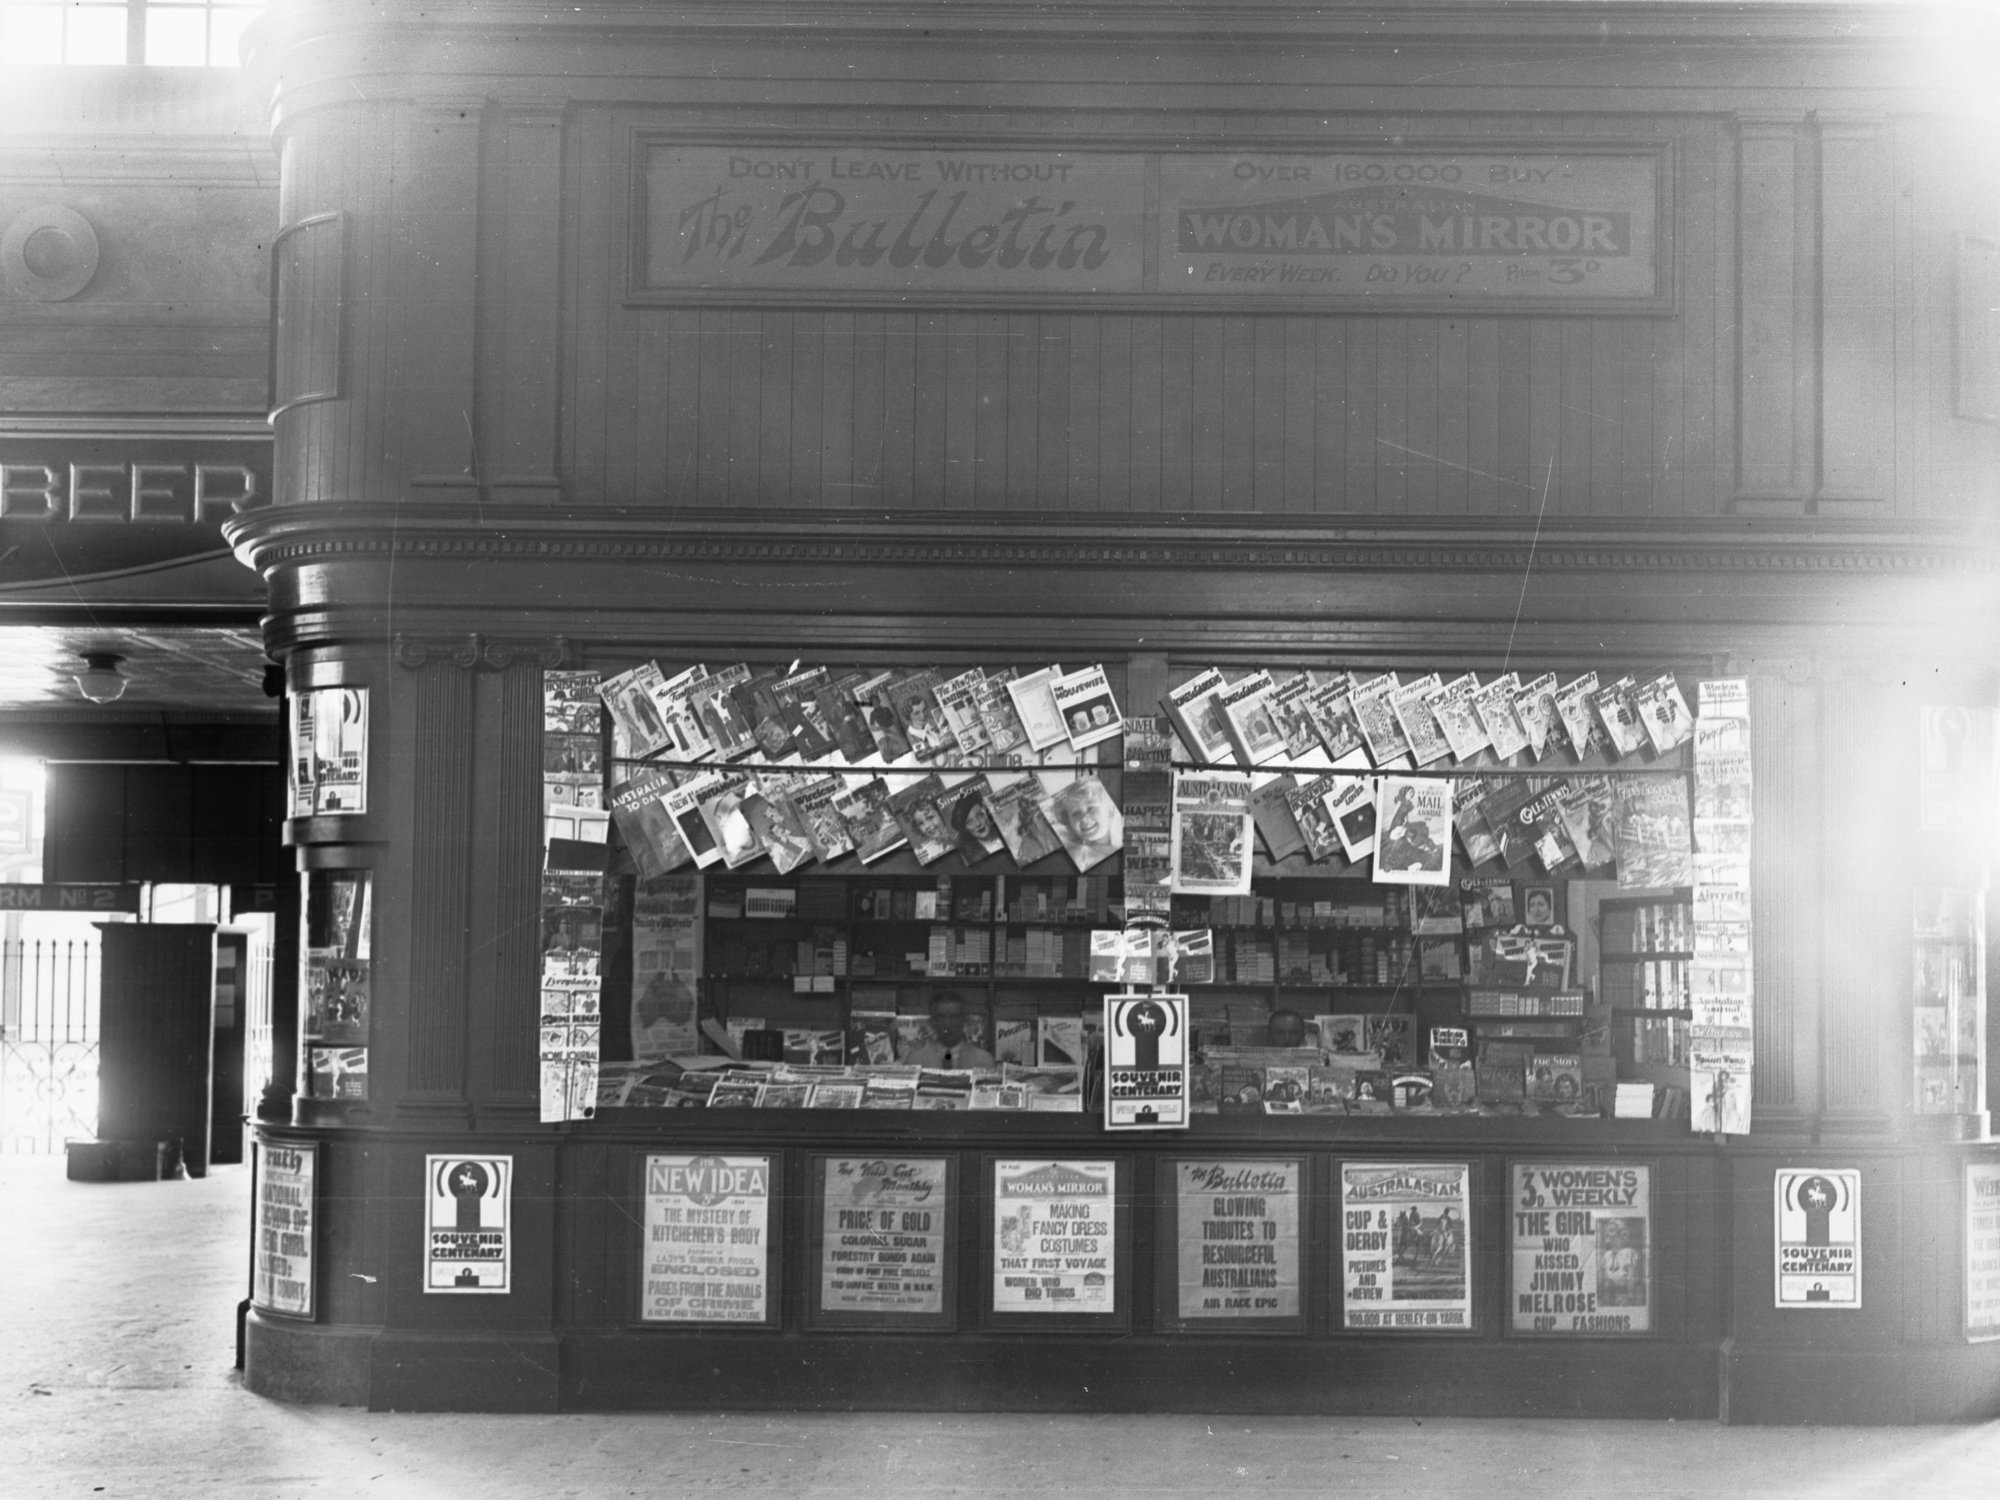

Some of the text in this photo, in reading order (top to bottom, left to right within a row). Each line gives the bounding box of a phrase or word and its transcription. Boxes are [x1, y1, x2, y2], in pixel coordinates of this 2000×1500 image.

[831, 156, 921, 182] LEAVE
[936, 160, 1073, 183] WITHOUT
[1233, 161, 1552, 184] OVER 160,000 BUY
[678, 181, 1111, 270] The Bulletin
[1187, 212, 1619, 251] WOMAN'S MIRROR
[1204, 261, 1276, 282] EVERY
[1365, 263, 1398, 283] DO
[0, 462, 256, 523] BEER
[1055, 676, 1106, 701] HOUSEWIFE
[611, 776, 669, 809] AUSTRALIA
[625, 791, 662, 814] TO DAY
[1417, 796, 1443, 809] MAIL
[1125, 805, 1168, 817] HAPPY
[1126, 857, 1171, 869] WEST
[93, 888, 116, 908] 2
[1696, 889, 1745, 905] Aircraft
[1533, 1057, 1552, 1067] rue
[1112, 1071, 1181, 1083] SOUVENIR
[1481, 1070, 1523, 1083] WINGS
[1111, 1085, 1181, 1097] CENTENARY
[266, 1150, 304, 1174] ruth
[652, 1167, 765, 1195] NEW IDEA
[1201, 1164, 1286, 1190] Bulletin
[1541, 1170, 1638, 1188] WOMEN'S
[881, 1177, 933, 1202] Monthly
[1007, 1182, 1103, 1193] WOMAN'S MIRROR
[1346, 1176, 1461, 1199] AUSTRALASIAN
[1551, 1188, 1638, 1206] WEEKLY
[1050, 1203, 1090, 1219] MAKING
[1213, 1197, 1266, 1217] GLOWING
[664, 1208, 752, 1225] THE MYSTERY OF
[839, 1209, 931, 1232] PRICE OF GOLD
[1346, 1210, 1388, 1230] CUP &
[1515, 1211, 1595, 1236] THE GIRL
[651, 1224, 761, 1245] KITCHENER'S BODY
[1032, 1220, 1108, 1236] FANCY DRESS
[1202, 1220, 1277, 1241] TRIBUTES TO
[432, 1233, 503, 1245] SOUVENIR
[841, 1235, 927, 1248] COLONIAL SUGAR
[1040, 1238, 1099, 1253] COSTUMES
[1346, 1231, 1388, 1251] DERBY
[1543, 1237, 1570, 1252] WHO
[431, 1247, 503, 1259] CENTENARY
[831, 1250, 875, 1262] FORESTRY
[1202, 1244, 1277, 1265] RESOURCEFUL
[1782, 1248, 1852, 1260] SOUVENIR
[1000, 1257, 1107, 1269] THAT FIRST VOYAGE
[1348, 1259, 1387, 1273] PICTURES
[1535, 1254, 1579, 1270] KISSED
[1781, 1261, 1853, 1273] CENTENARY
[650, 1264, 760, 1278] ENCLOSED
[1202, 1268, 1277, 1289] AUSTRALIANS
[1004, 1276, 1061, 1288] WOMEN WHO
[1358, 1273, 1376, 1286] AND
[1529, 1271, 1584, 1291] JIMMY
[648, 1280, 678, 1298] PAGES
[679, 1281, 706, 1298] FROM
[707, 1282, 724, 1298] THE
[1025, 1287, 1075, 1298] DID THINGS
[1352, 1287, 1383, 1300] REVIEW
[654, 1297, 755, 1311] OF CRIME
[1203, 1297, 1279, 1309] AIR RACE EPIC
[1519, 1293, 1596, 1313] MELROSE
[1383, 1312, 1392, 1325] AT
[1534, 1315, 1631, 1331] CUP FASHIONS
